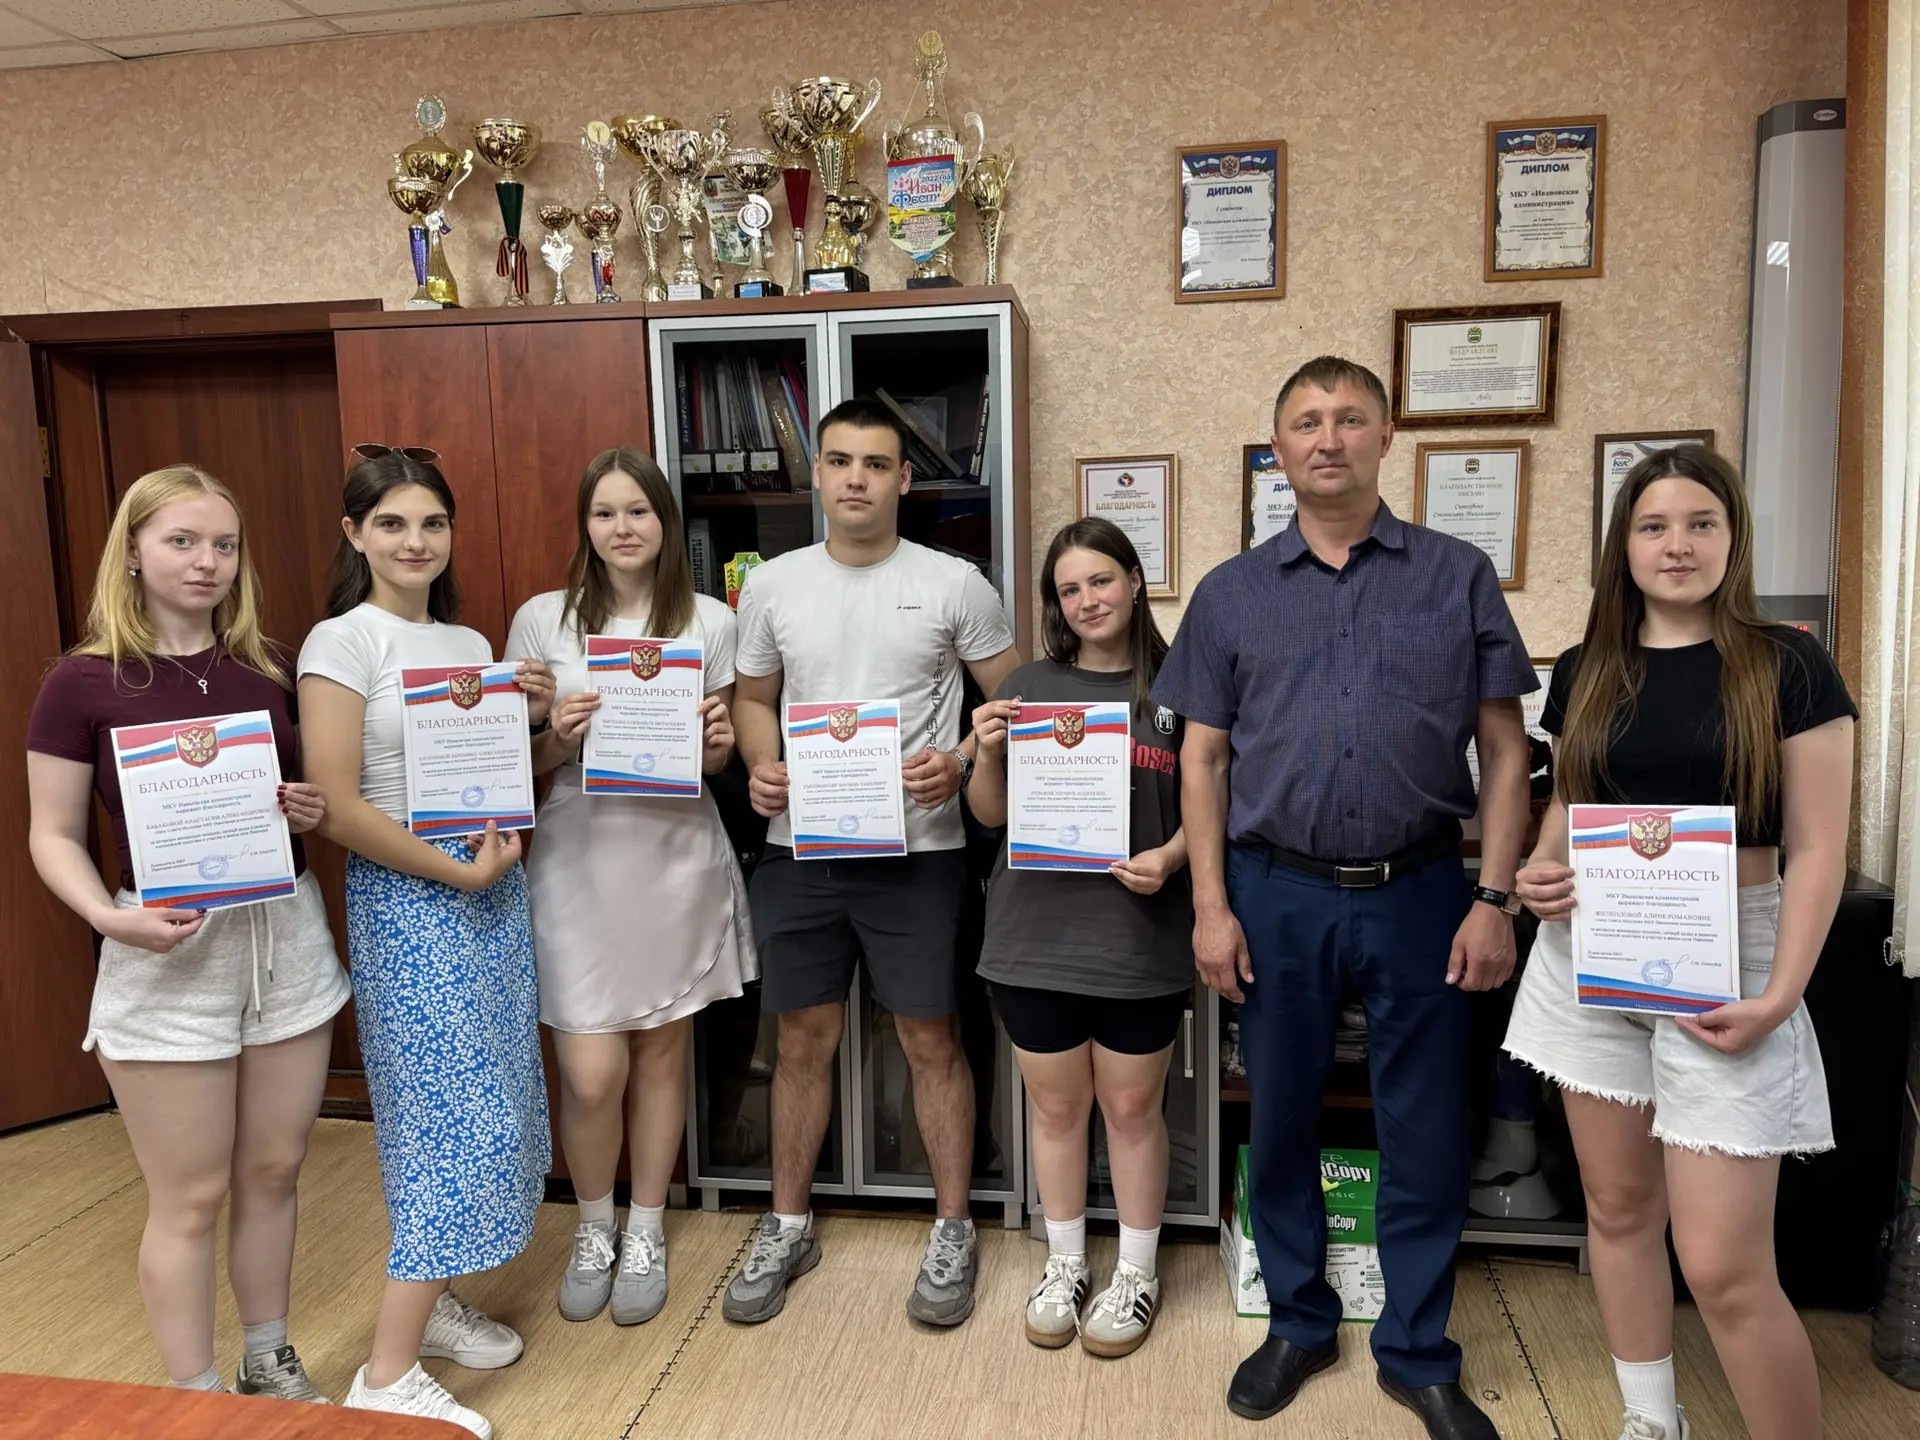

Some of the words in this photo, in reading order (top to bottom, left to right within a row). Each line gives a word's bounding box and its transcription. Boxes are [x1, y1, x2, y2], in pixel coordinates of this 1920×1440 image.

[1521, 164, 1569, 175] ДИПЛОМ
[908, 178, 942, 194] Иван
[1207, 186, 1252, 197] ДИПЛОМ
[1510, 190, 1529, 198] МКУ
[1514, 200, 1575, 210] администрация»
[1096, 501, 1156, 511] БЛАГОДАРНОСТЬ
[597, 686, 693, 697] БЛАГОДАРНОСТЬ
[417, 714, 518, 729] БЛАГОДАРНОСТЬ
[798, 748, 890, 760] БЛАГОДАРНОСТЬ
[1020, 756, 1118, 765] БЛАГОДАРНОСТЬ
[139, 769, 266, 793] БЛАГОДАРНОСТЬ
[1586, 868, 1720, 882] БЛАГОДАРНОСТЬ
